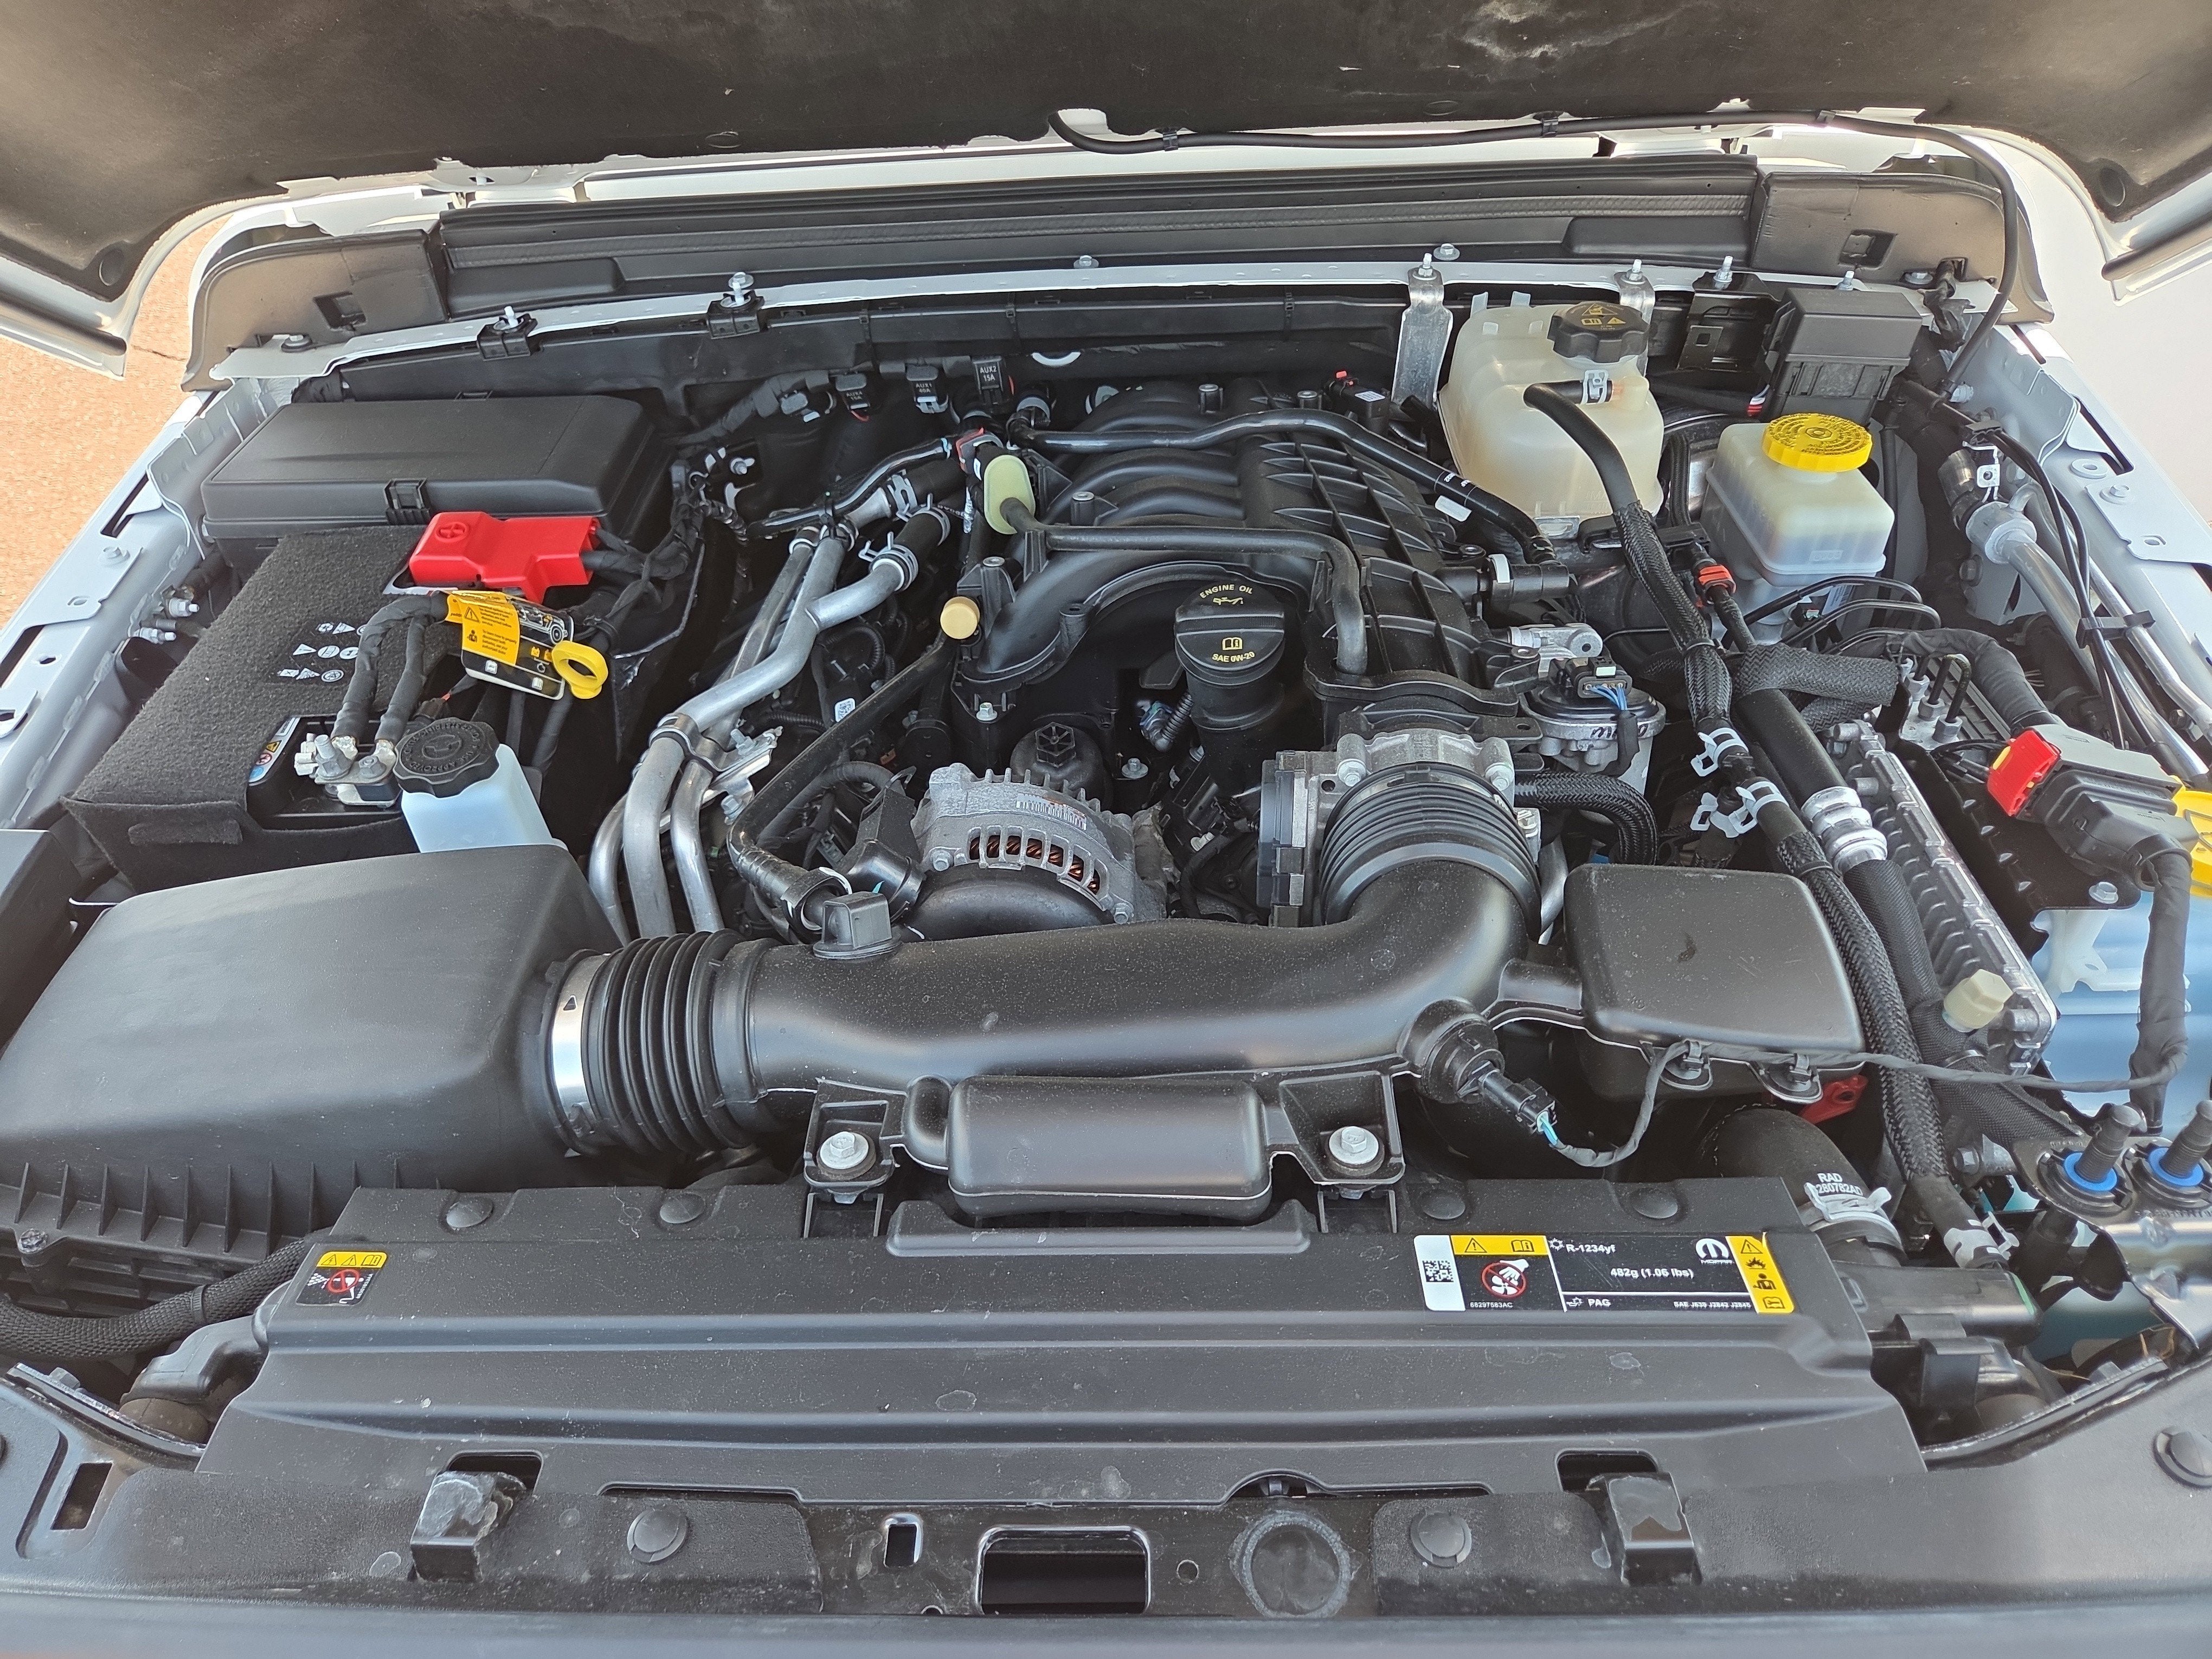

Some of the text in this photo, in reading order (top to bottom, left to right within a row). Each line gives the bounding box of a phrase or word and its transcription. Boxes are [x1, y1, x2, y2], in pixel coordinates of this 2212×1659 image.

[983, 374, 995, 382] 15A
[1199, 584, 1253, 599] ENGINE OIL
[1212, 651, 1255, 663] SAE 0W-20
[409, 760, 456, 773] APPROVED
[1817, 1173, 1843, 1183] RAD
[1566, 1244, 1616, 1255] R-1234yf
[1610, 1268, 1694, 1279] 482g (1.06 lbs)
[1587, 1298, 1611, 1307] PAG
